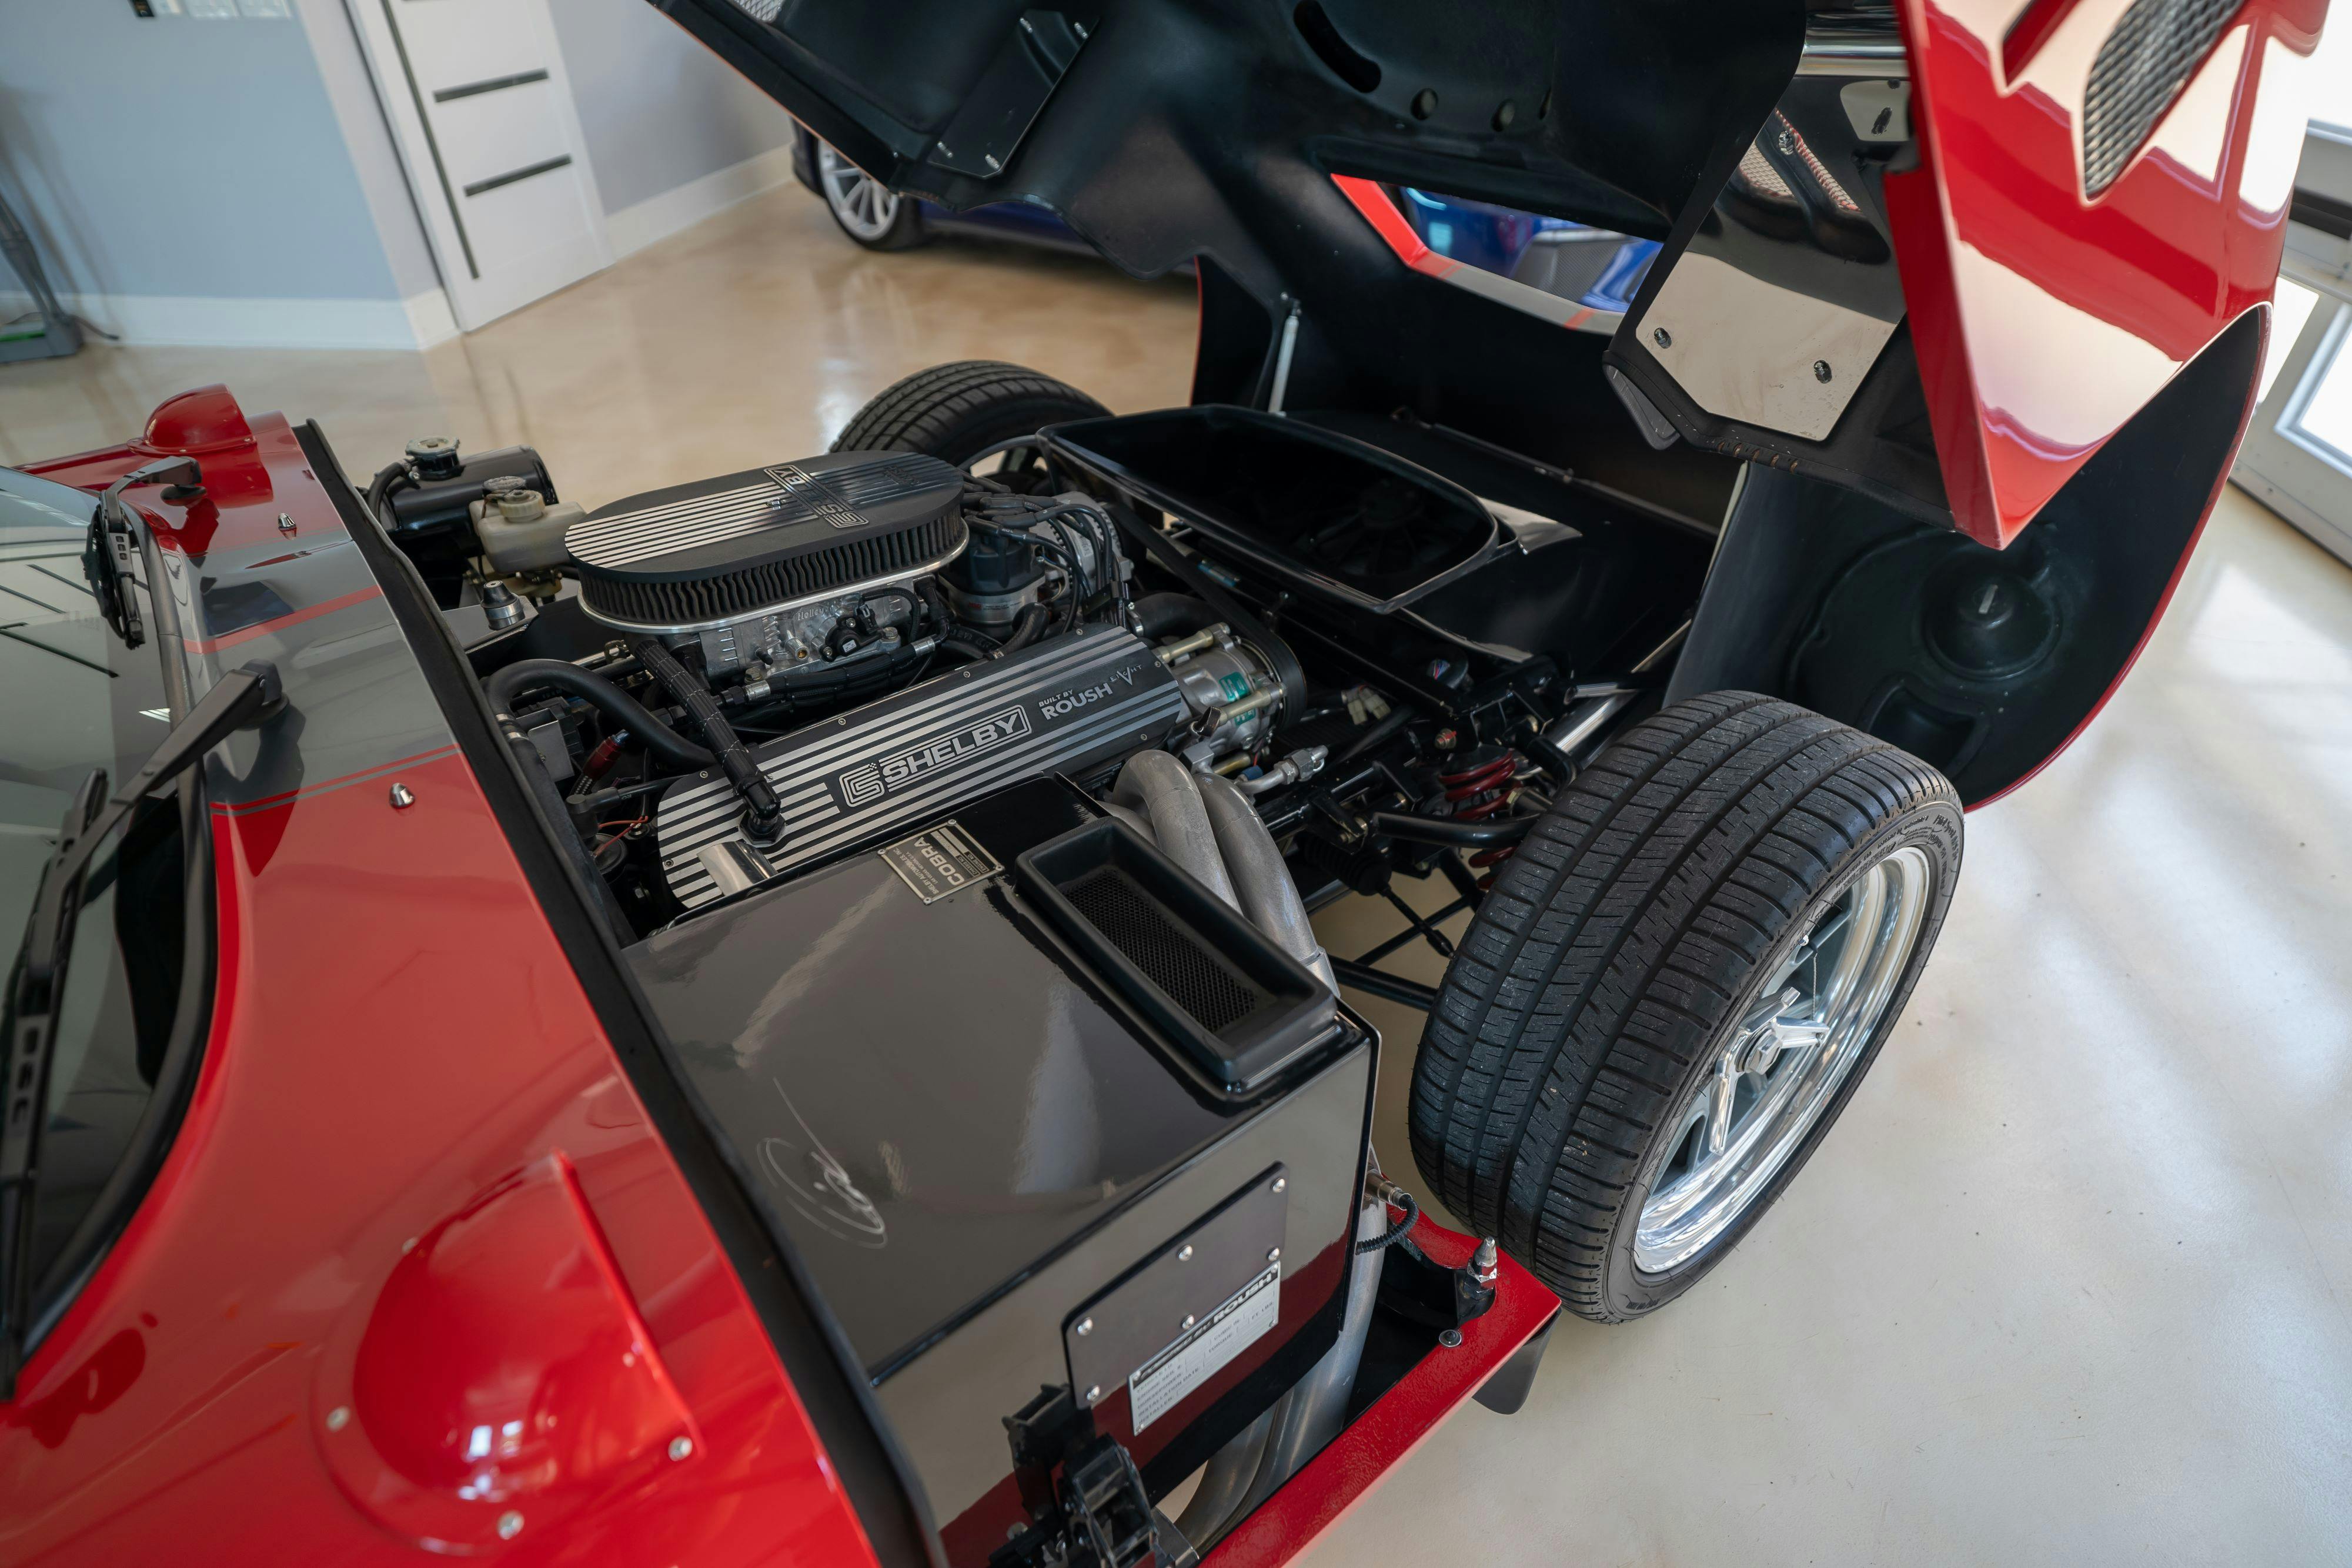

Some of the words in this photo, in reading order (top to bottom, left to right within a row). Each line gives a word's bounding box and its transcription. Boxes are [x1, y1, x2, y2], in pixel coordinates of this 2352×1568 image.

[797, 607, 823, 621] Holley
[1038, 694, 1061, 707] BUILT
[1063, 689, 1073, 698] BY
[1041, 683, 1113, 720] ROUSH
[882, 713, 1018, 783] SHELBY
[914, 837, 964, 885] COBRA
[921, 878, 940, 894] SHELBY
[1213, 1271, 1271, 1325] ROUSH
